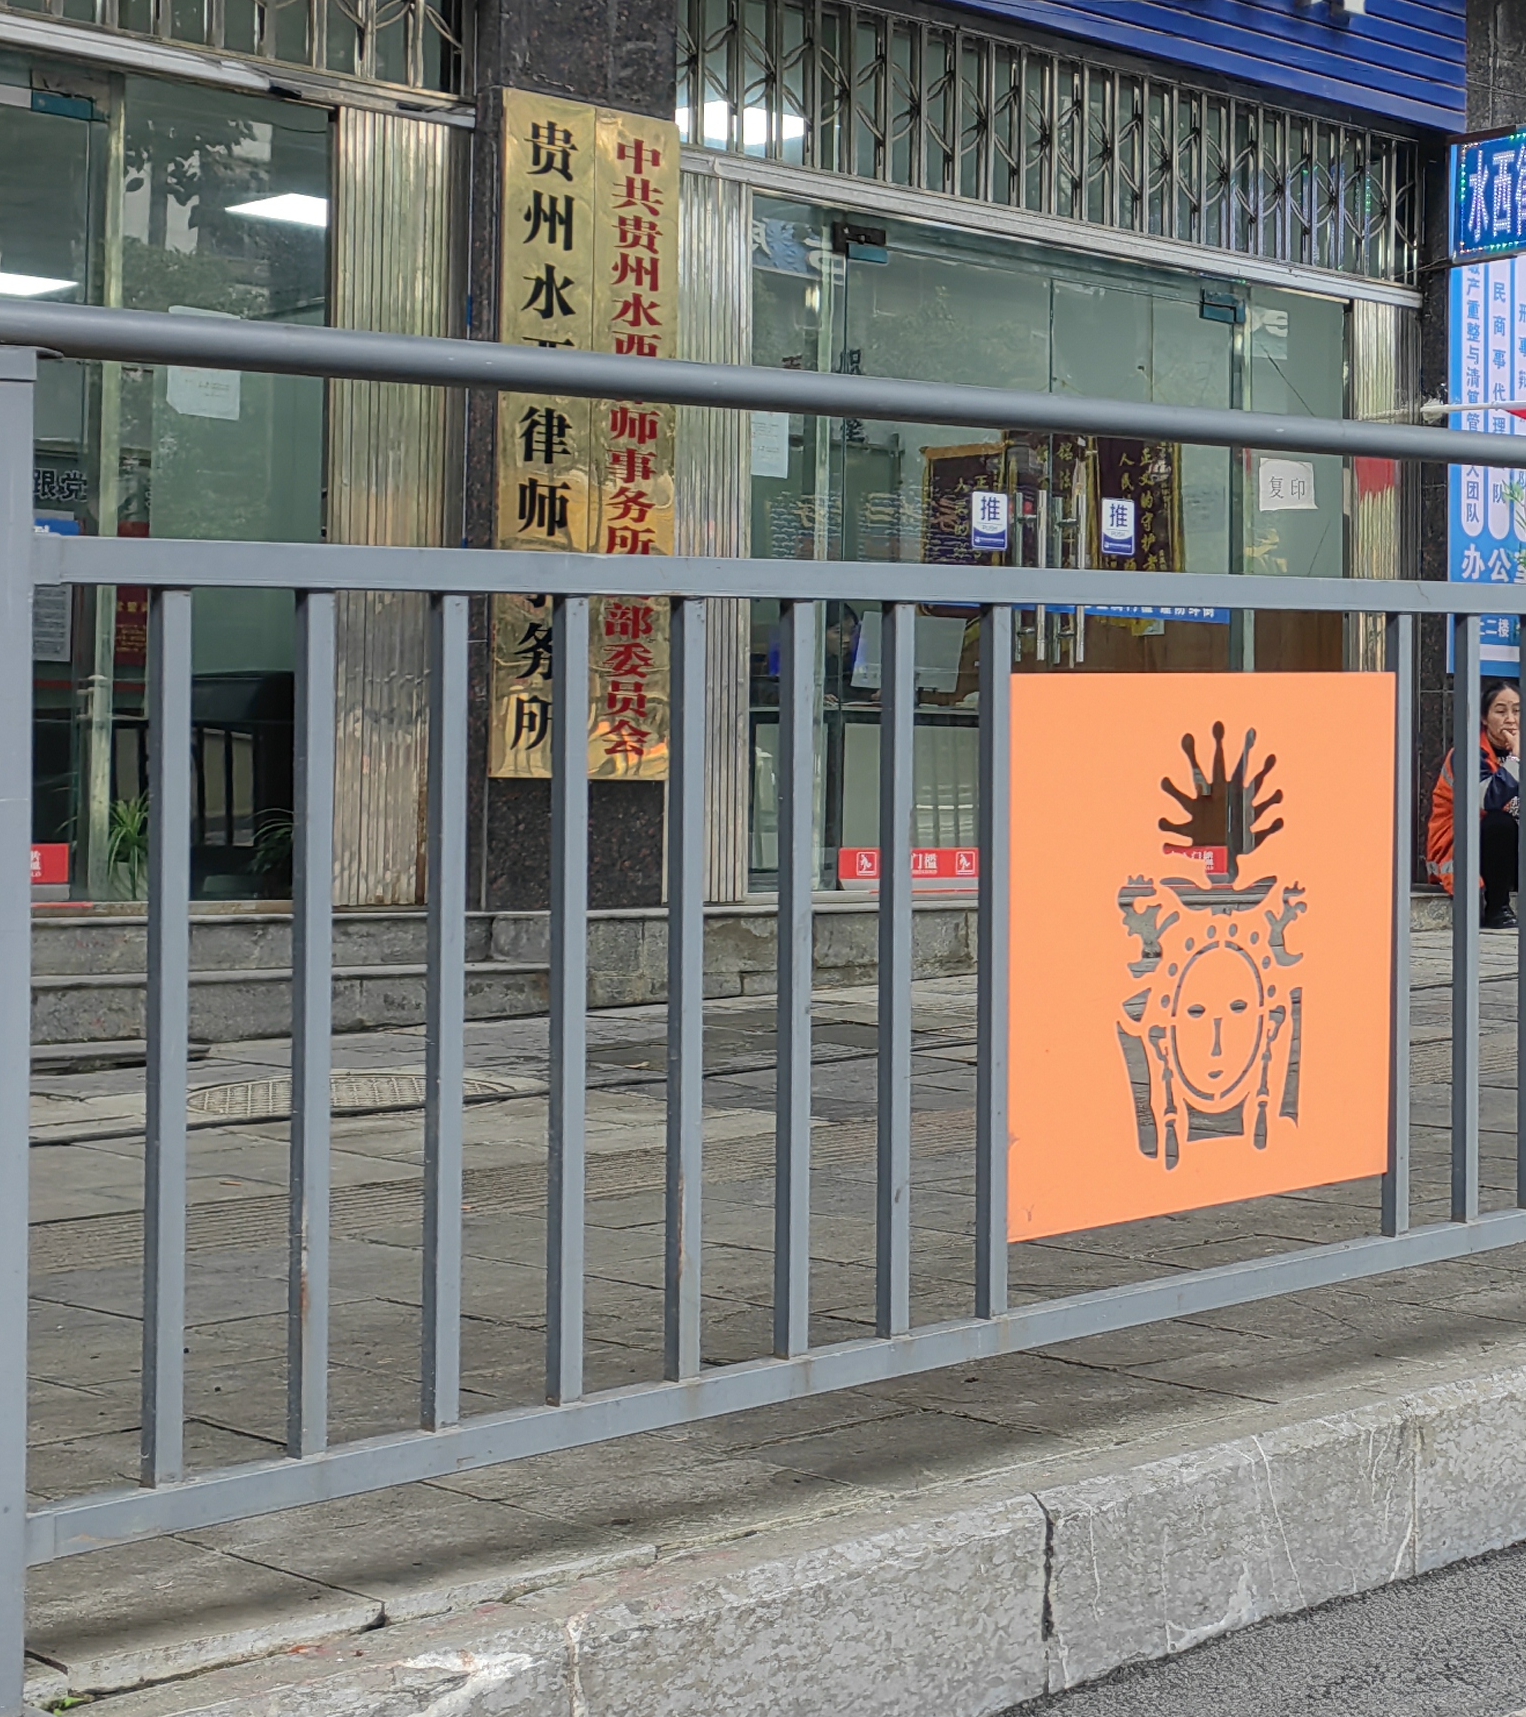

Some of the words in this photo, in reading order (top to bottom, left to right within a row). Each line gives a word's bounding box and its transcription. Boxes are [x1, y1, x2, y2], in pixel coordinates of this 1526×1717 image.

[510, 119, 579, 751] 贵州水律师务所
[604, 138, 664, 756] 中共贵州水西师事务所部委员会
[1269, 475, 1306, 500] 复印
[980, 495, 1000, 521] 推
[1109, 503, 1128, 528] 推
